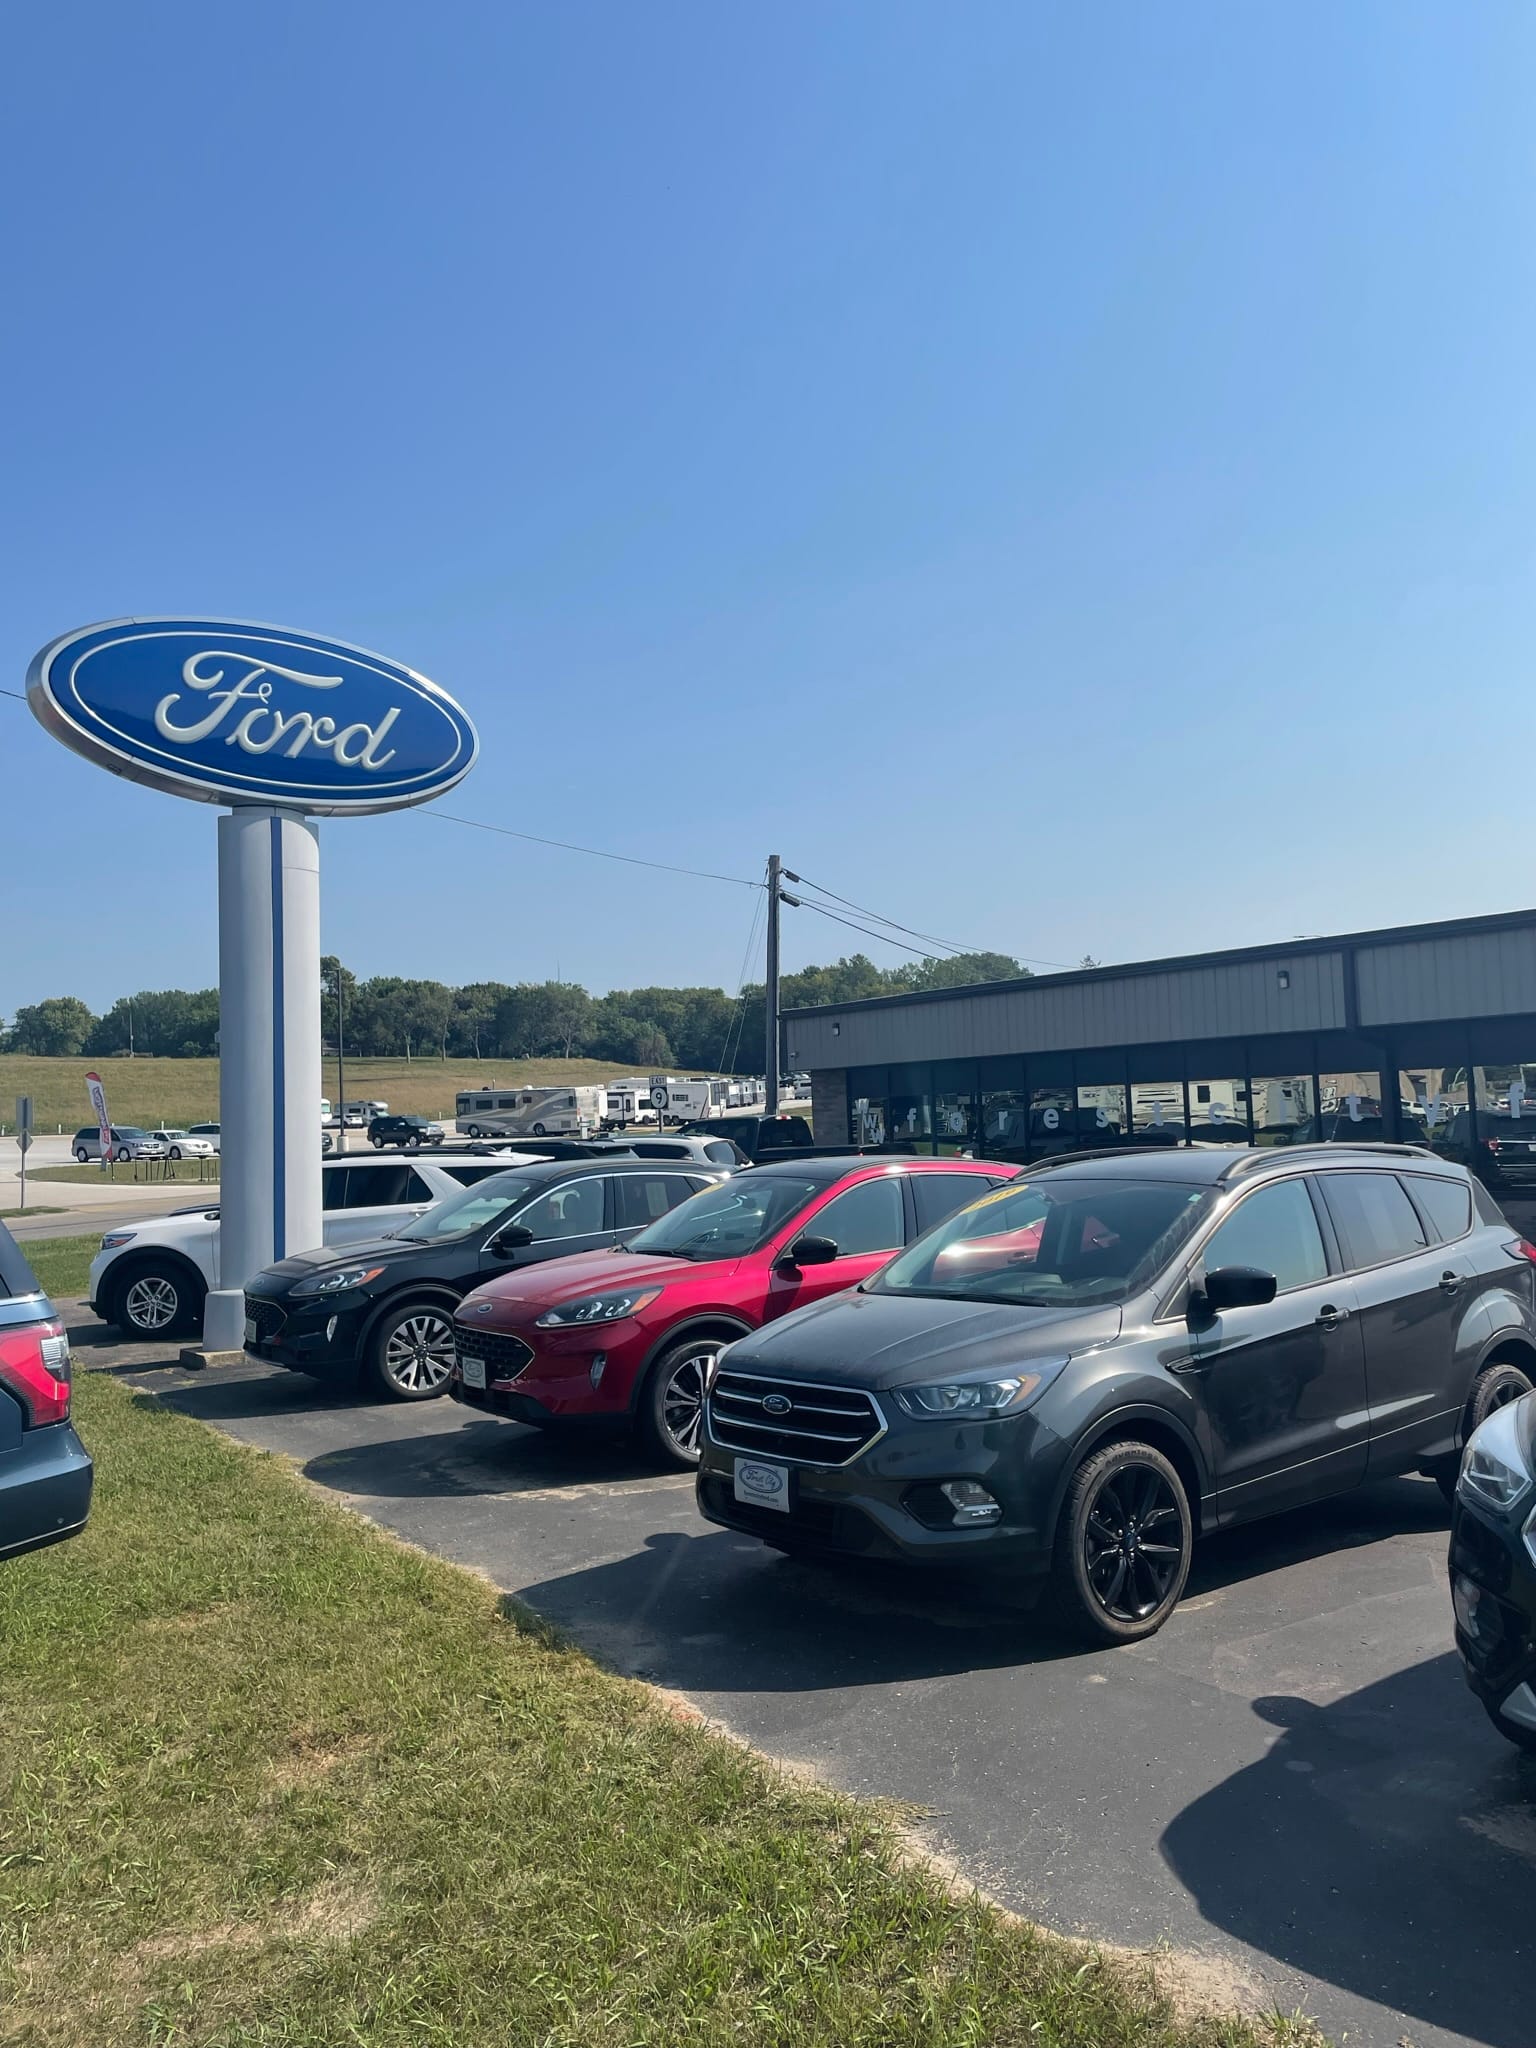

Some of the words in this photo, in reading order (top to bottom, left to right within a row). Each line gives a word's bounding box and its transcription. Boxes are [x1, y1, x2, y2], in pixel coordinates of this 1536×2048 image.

[155, 650, 402, 772] Ford
[651, 1077, 665, 1085] EAST
[655, 1092, 662, 1105] 9
